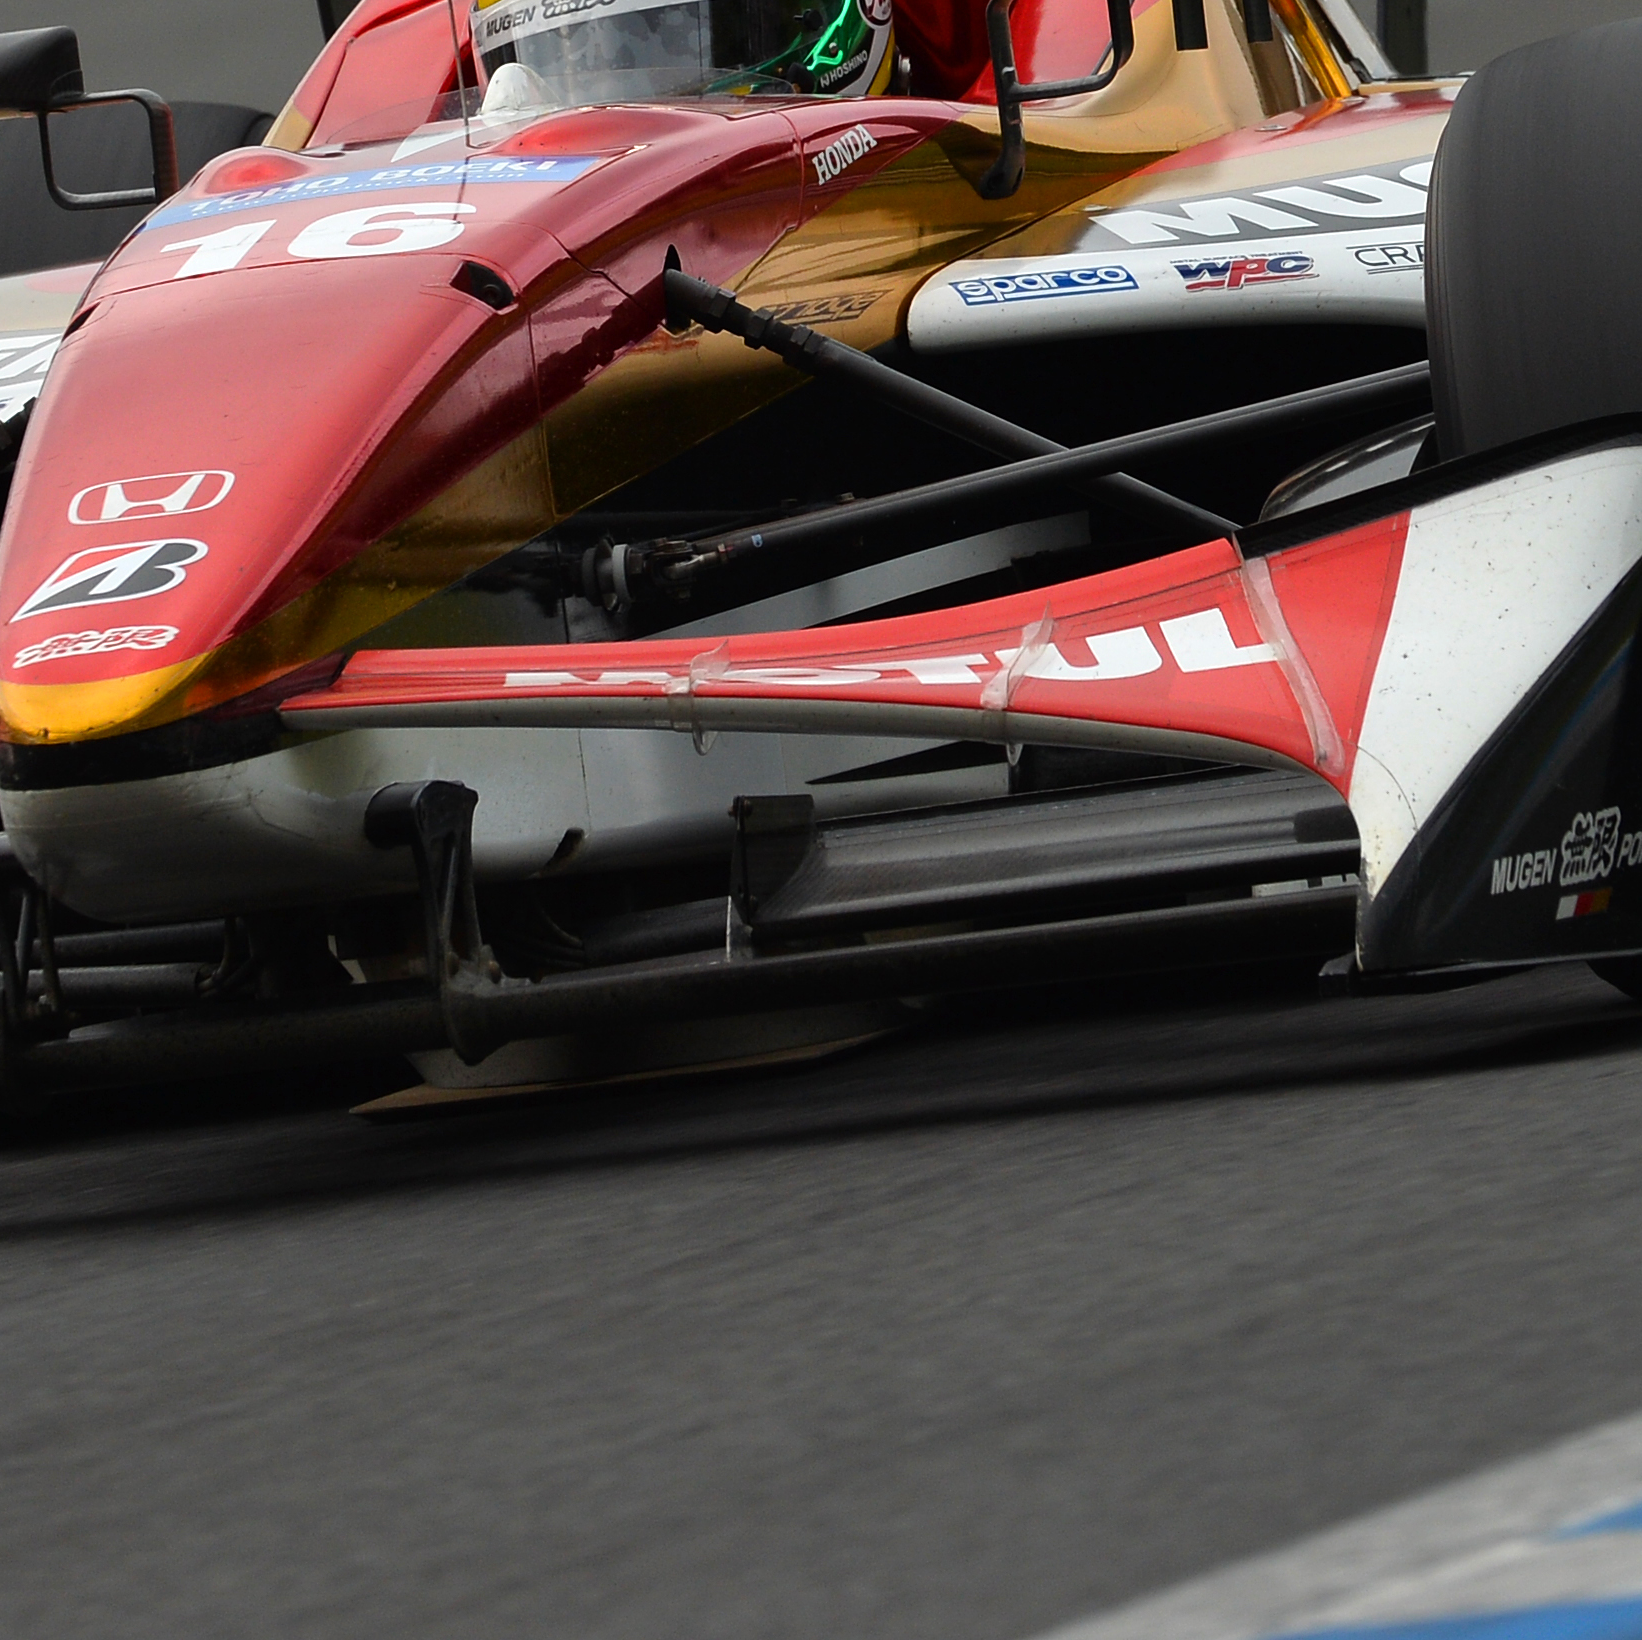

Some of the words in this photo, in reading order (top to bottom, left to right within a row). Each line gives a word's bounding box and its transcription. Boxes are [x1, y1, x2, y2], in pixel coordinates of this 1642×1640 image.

[485, 5, 536, 37] MUGEN
[811, 123, 878, 186] HONDA
[189, 176, 349, 212] TOHO
[370, 160, 559, 182] BOEKI
[160, 202, 477, 279] 16
[957, 266, 1129, 302] sparco
[1490, 848, 1558, 895] MUGEN
